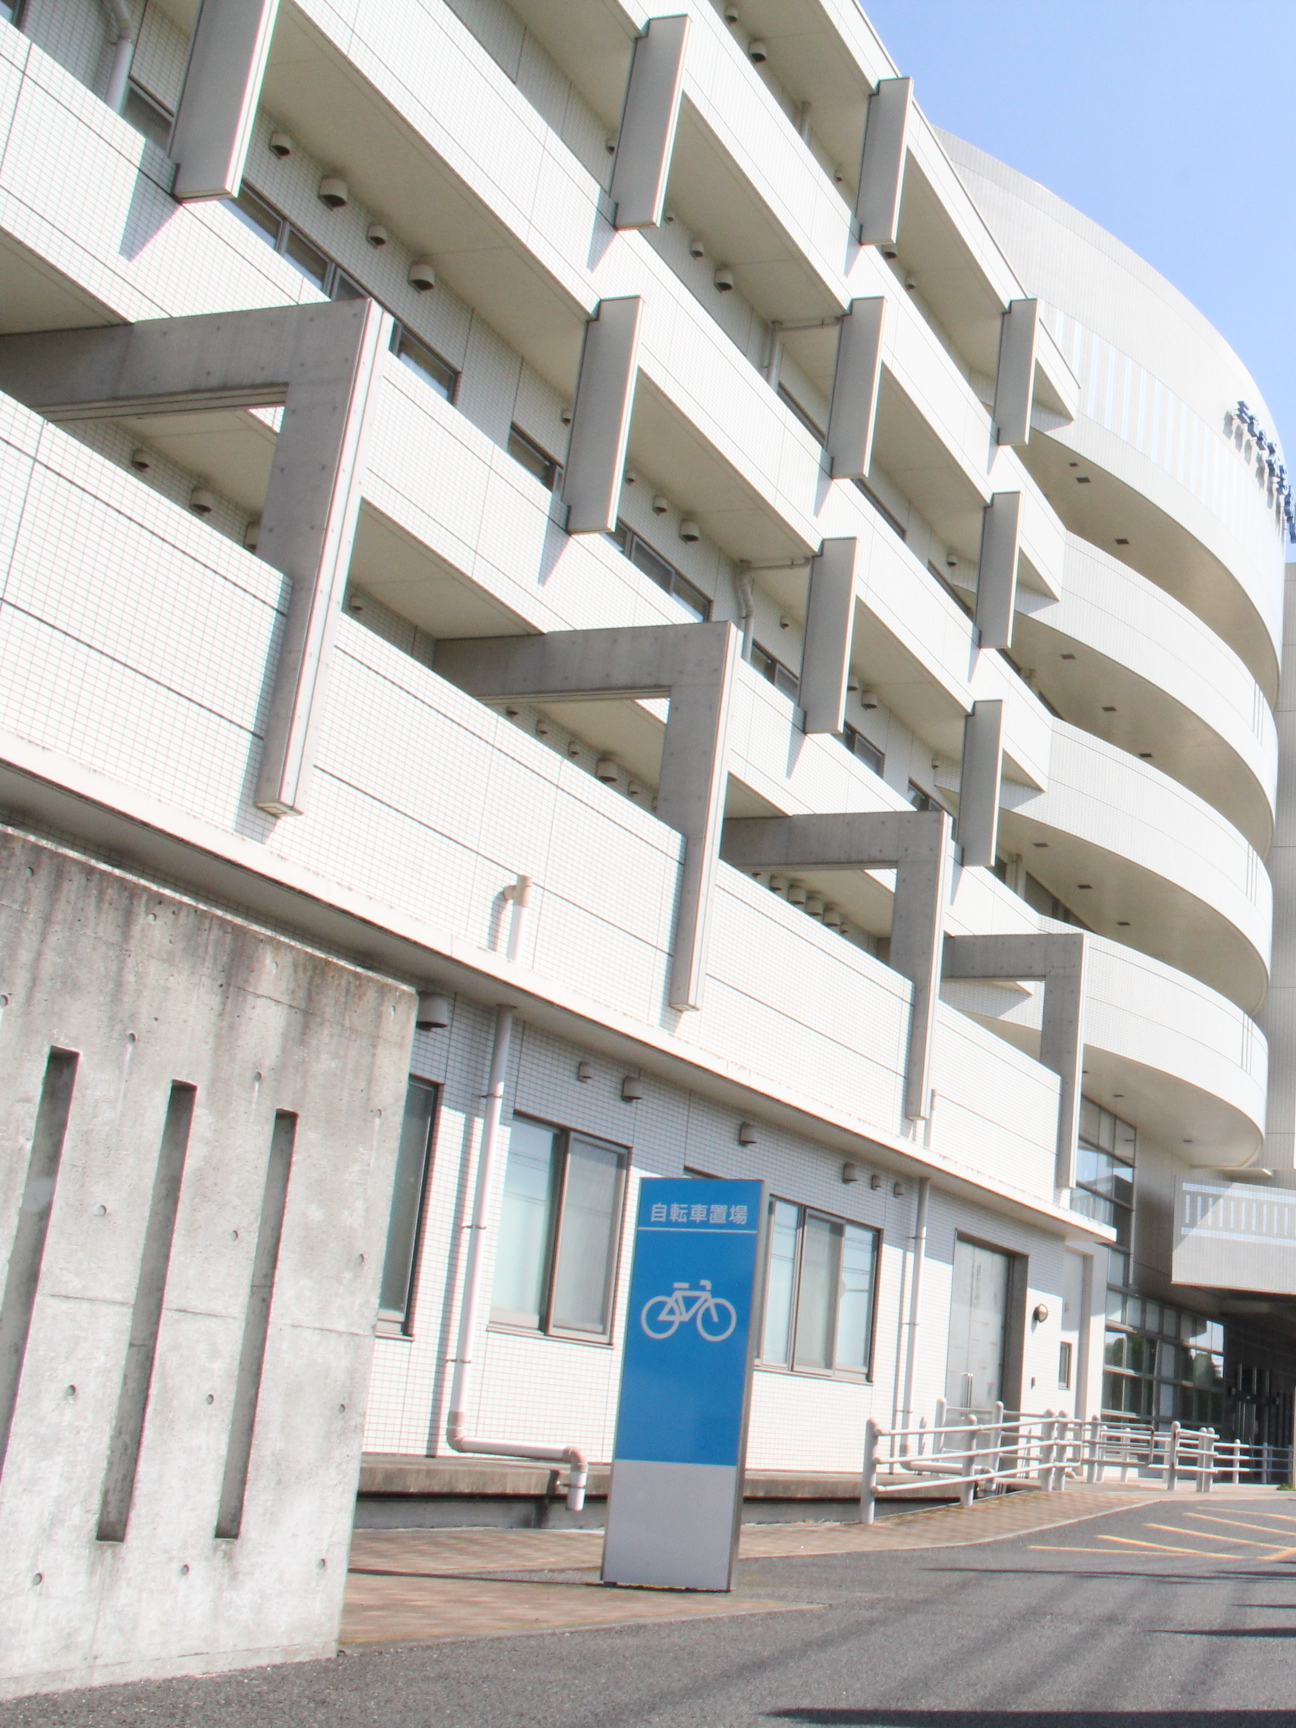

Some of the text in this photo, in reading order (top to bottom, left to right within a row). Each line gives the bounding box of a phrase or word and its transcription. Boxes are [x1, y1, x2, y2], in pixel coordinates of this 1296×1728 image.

[651, 1203, 748, 1225] 自転車置場
